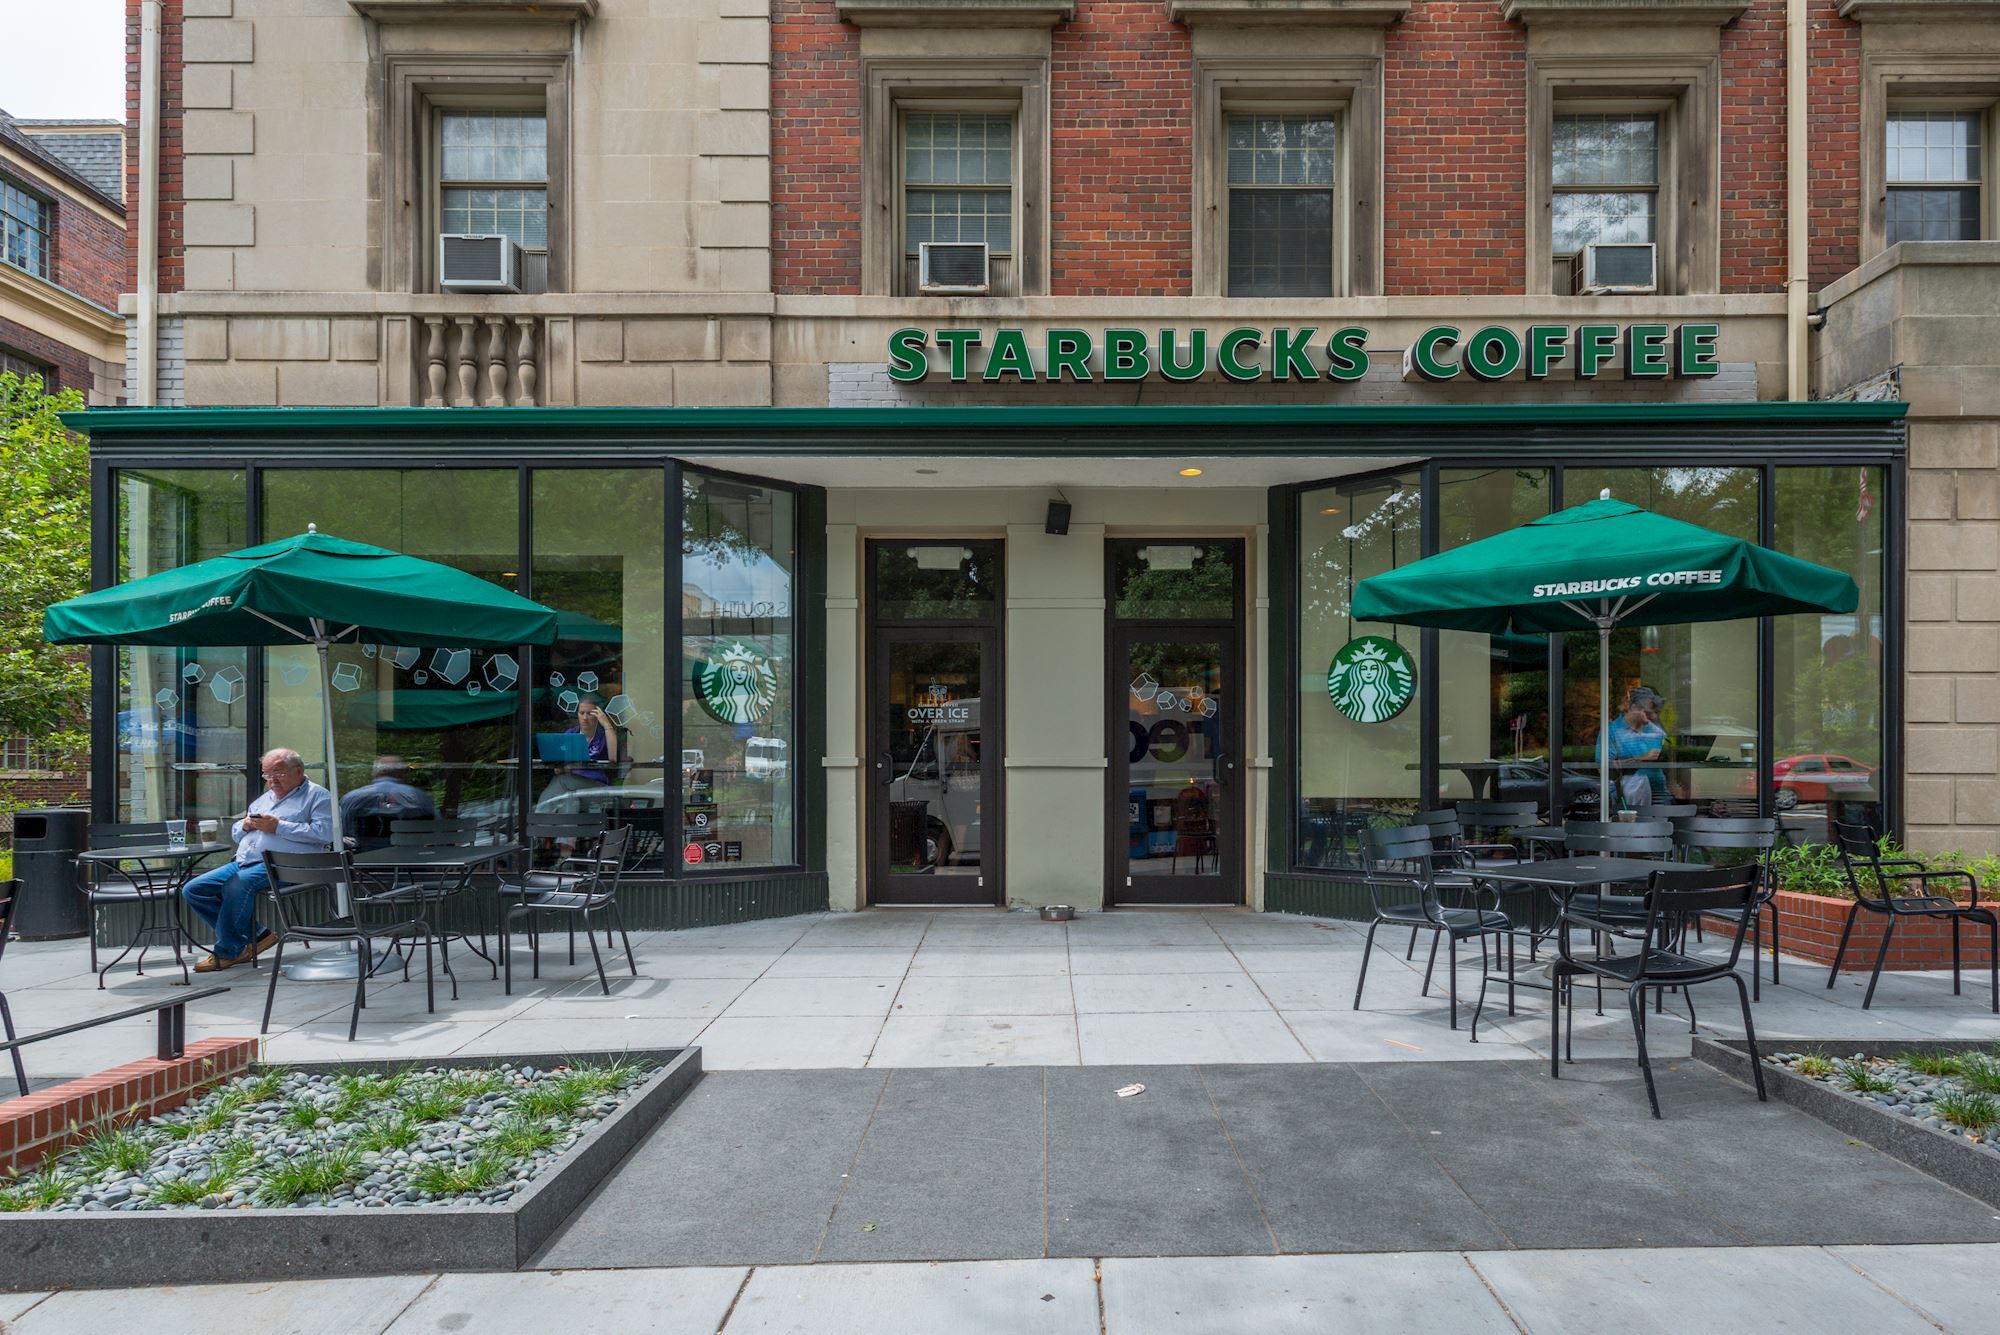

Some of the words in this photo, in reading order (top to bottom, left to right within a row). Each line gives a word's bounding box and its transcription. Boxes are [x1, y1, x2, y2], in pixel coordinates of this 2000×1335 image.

[886, 326, 1370, 384] STARBUCKS
[1412, 323, 1720, 383] COFFEE
[1532, 576, 1642, 598] STARBUCKS
[1646, 569, 1722, 587] COFFEE
[907, 708, 944, 719] OVER
[948, 708, 969, 719] ICE
